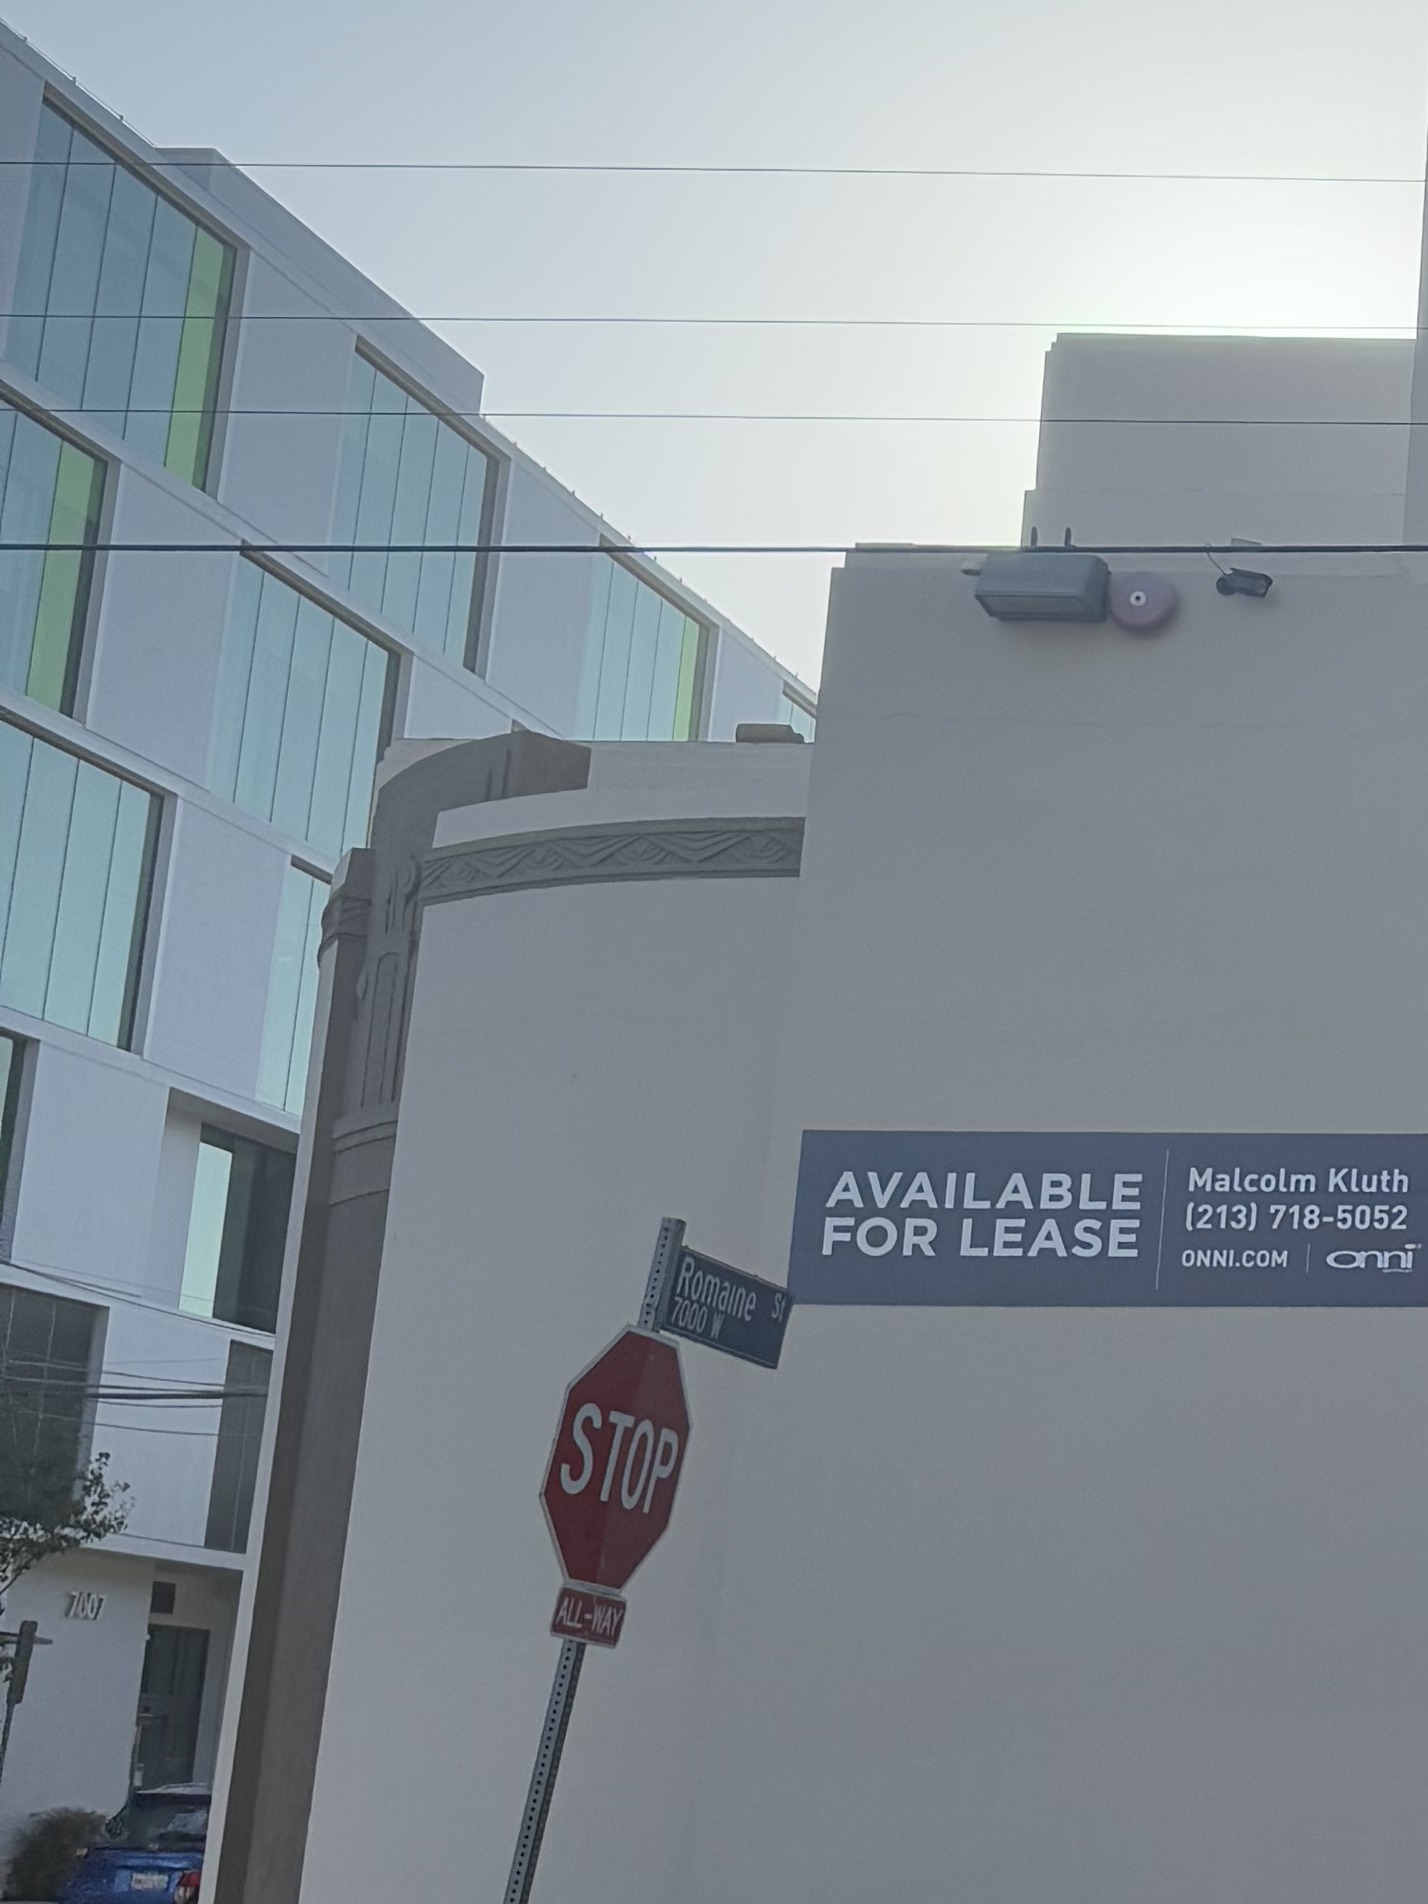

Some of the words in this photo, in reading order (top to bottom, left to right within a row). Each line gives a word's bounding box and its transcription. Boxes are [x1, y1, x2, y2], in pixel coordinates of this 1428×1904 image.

[825, 1170, 1144, 1211] AVAILABLE
[1187, 1167, 1318, 1194] Malcolm
[1327, 1167, 1410, 1194] Kluth
[821, 1216, 936, 1257] FOR
[959, 1217, 1141, 1258] LEASE
[1184, 1202, 1259, 1233] (213)
[1269, 1203, 1409, 1232] 718-5052
[1180, 1248, 1289, 1269] ONNI.COM
[1325, 1243, 1416, 1270] onni
[676, 1255, 758, 1322] Romaine
[771, 1292, 787, 1323] St
[671, 1296, 709, 1334] 7000
[710, 1312, 726, 1339] W
[559, 1402, 680, 1514] STOP
[555, 1596, 626, 1637] ALL-WAY
